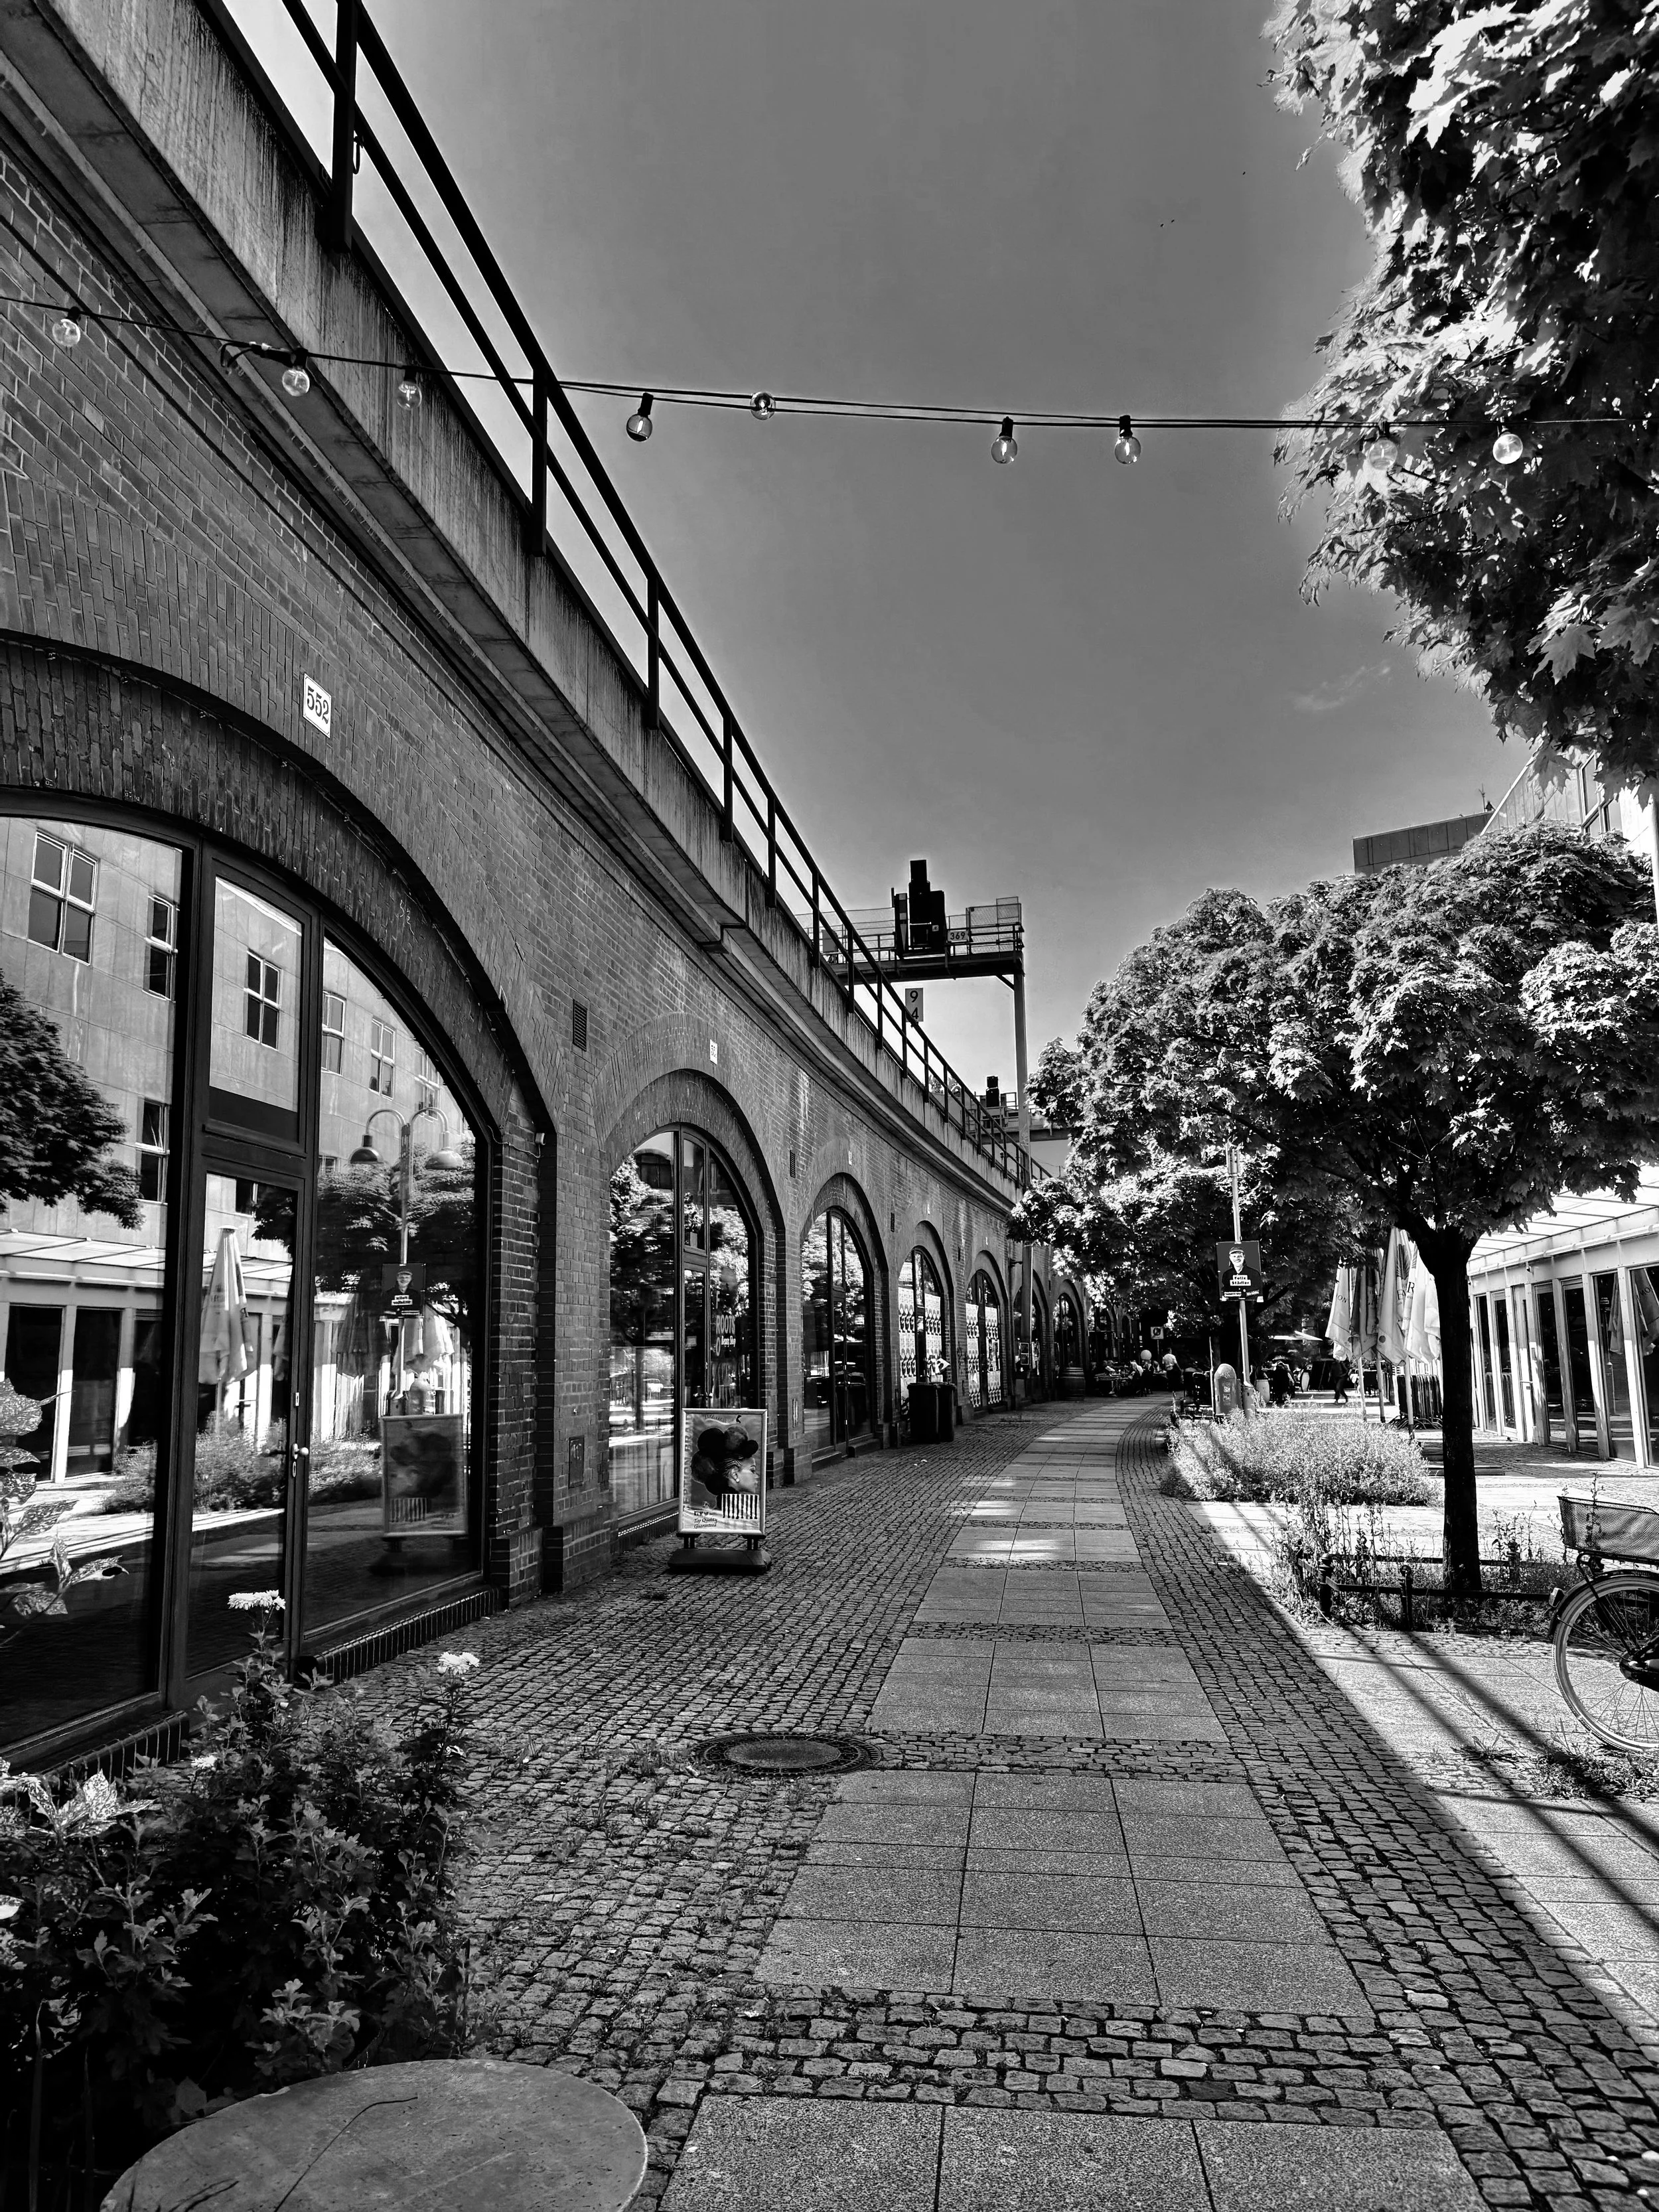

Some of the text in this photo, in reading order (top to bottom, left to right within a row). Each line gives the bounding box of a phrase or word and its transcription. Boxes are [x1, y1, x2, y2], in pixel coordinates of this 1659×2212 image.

[307, 685, 329, 724] 552
[950, 932, 966, 940] 369
[716, 1314, 735, 1334] ROOTS
